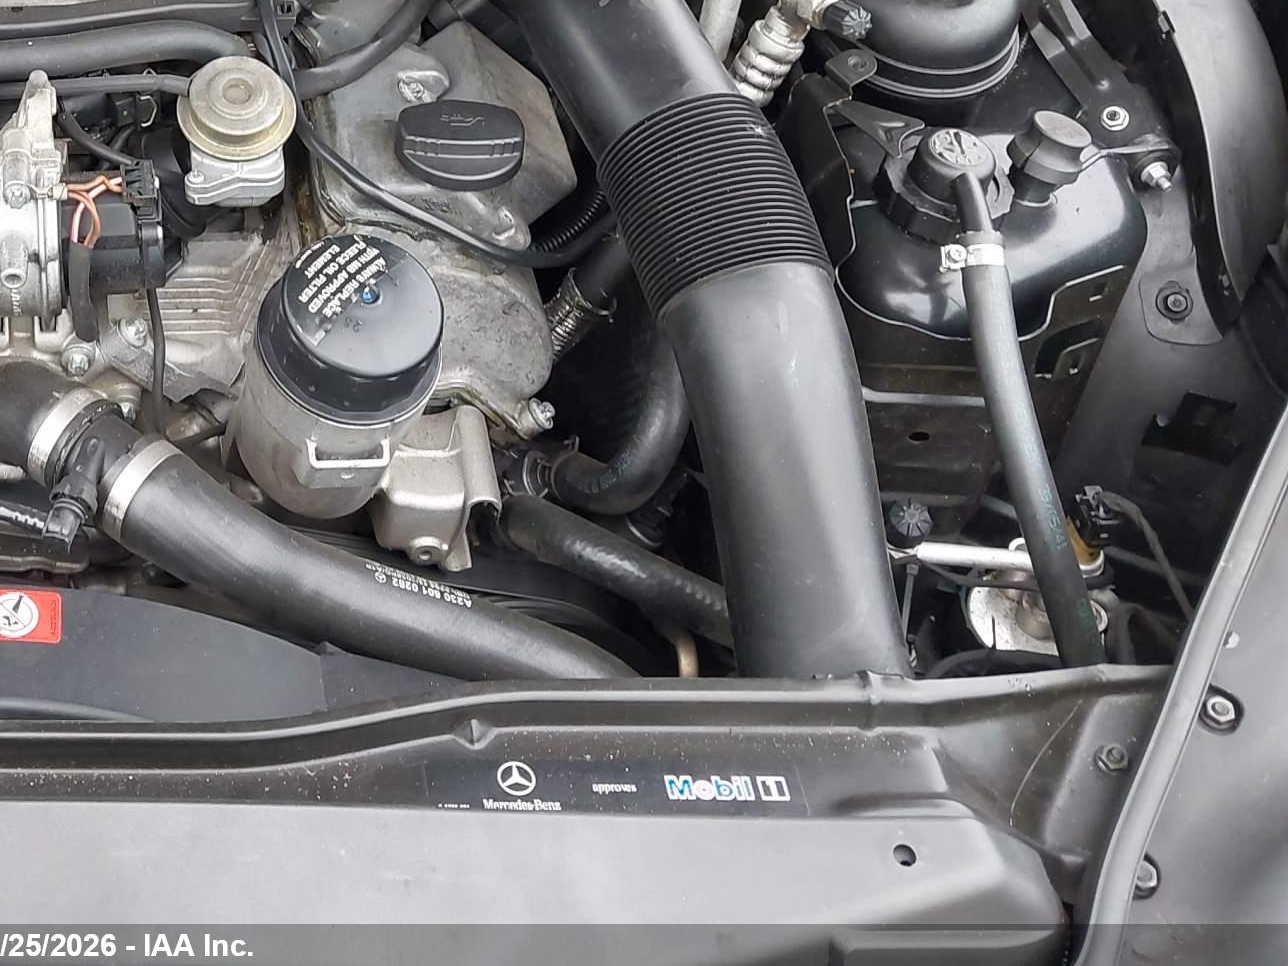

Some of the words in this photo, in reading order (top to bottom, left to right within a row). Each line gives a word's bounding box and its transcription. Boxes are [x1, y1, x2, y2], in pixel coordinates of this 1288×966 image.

[304, 244, 341, 279] ELEMENT
[335, 240, 367, 265] FLEECE
[322, 262, 340, 276] OIL
[346, 259, 362, 274] MB
[356, 256, 386, 283] ALWAYS
[298, 273, 327, 303] FILTER
[308, 269, 349, 314] APPROVED
[322, 279, 359, 318] REPLACE
[443, 592, 472, 608] A230
[592, 783, 637, 794] approves
[664, 775, 756, 801] Mobil
[756, 776, 792, 801] 1
[483, 798, 562, 811] Mercedes-Benz
